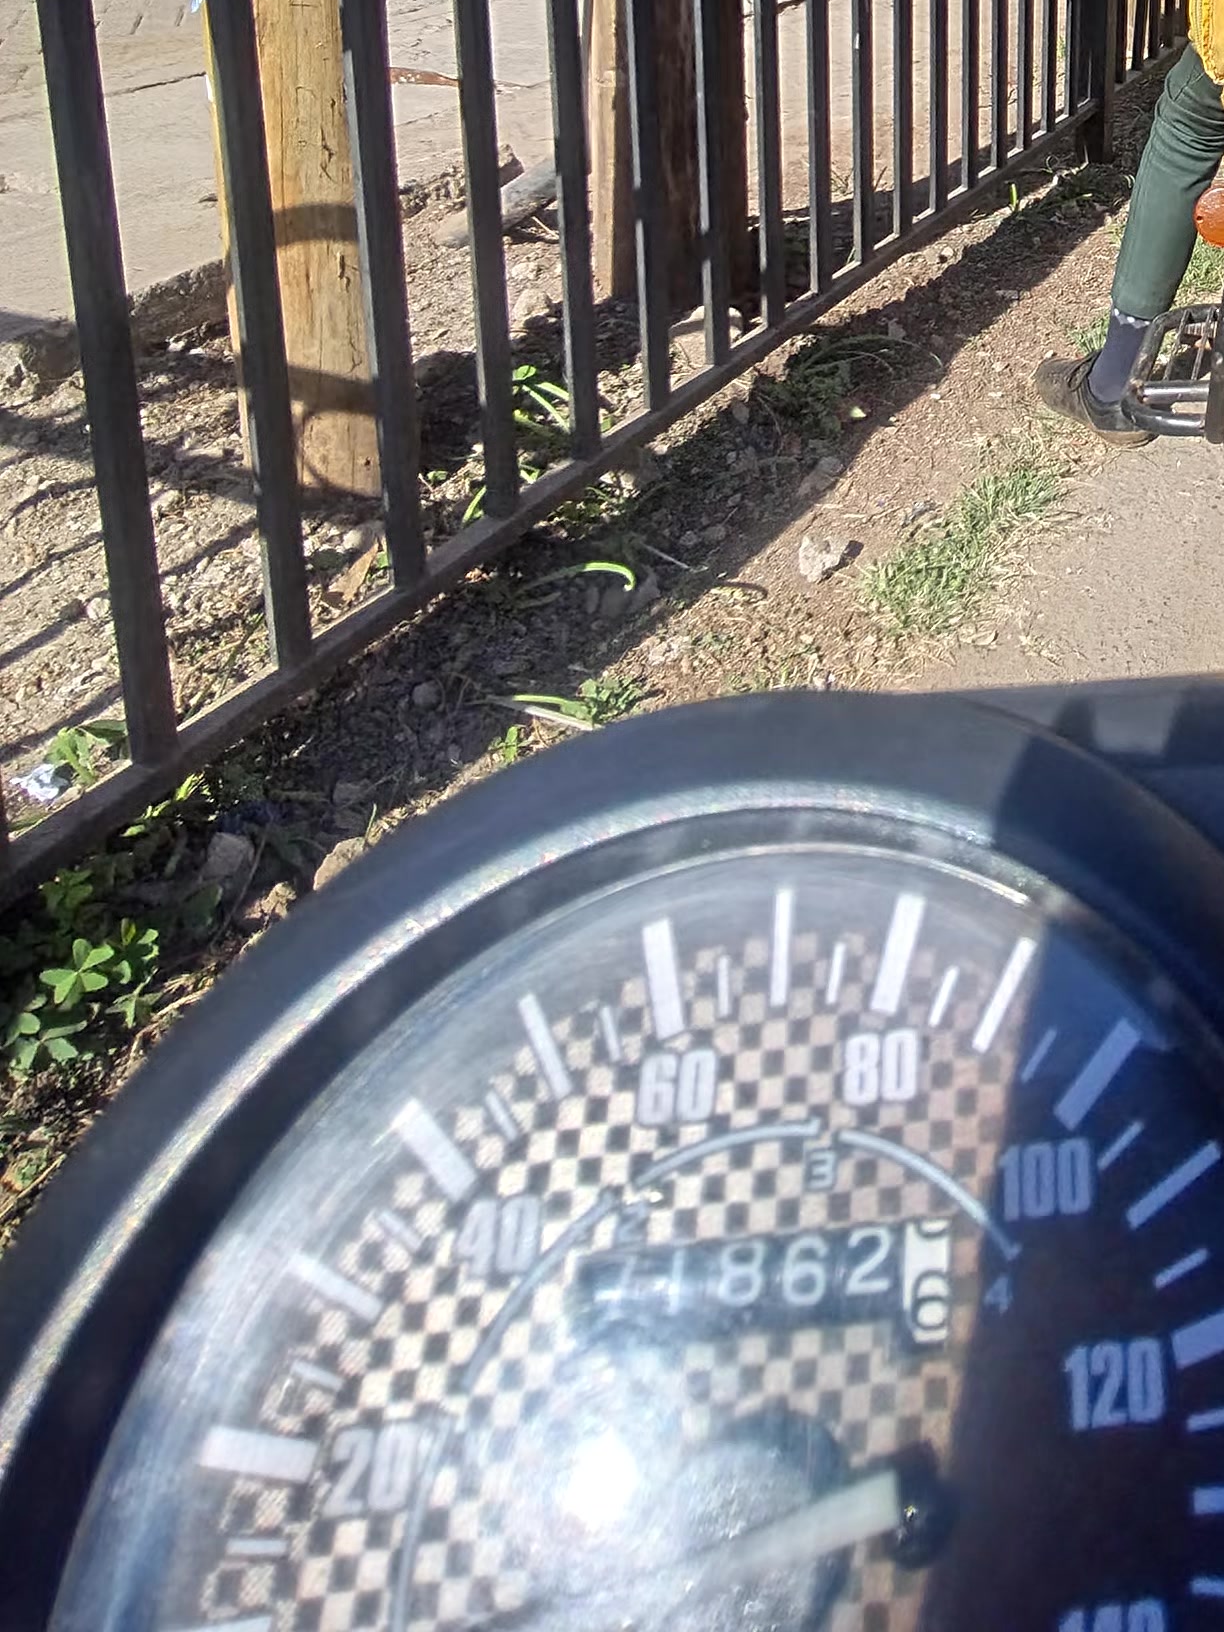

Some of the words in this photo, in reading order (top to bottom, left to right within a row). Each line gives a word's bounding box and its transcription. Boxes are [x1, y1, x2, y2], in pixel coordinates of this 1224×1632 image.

[637, 1047, 718, 1127] 60
[841, 1029, 920, 1107] 80
[1001, 1136, 1094, 1220] 100
[456, 1193, 541, 1275] 40
[1063, 1335, 1167, 1433] 120
[321, 1421, 416, 1517] 20
